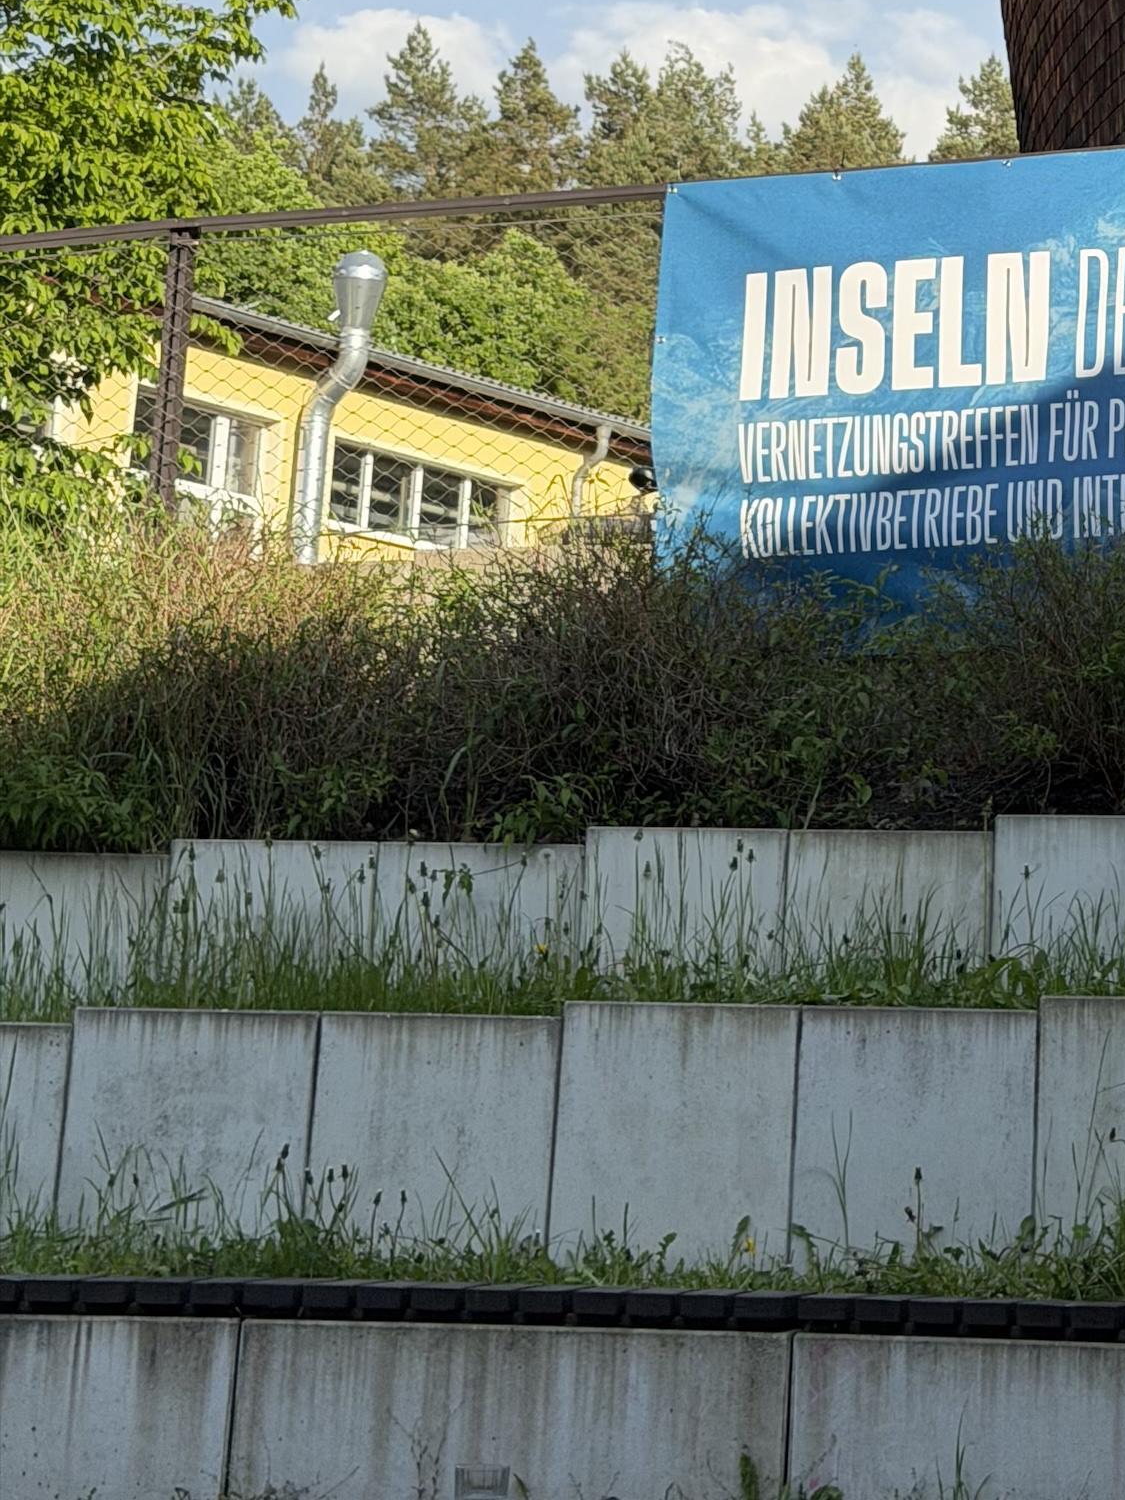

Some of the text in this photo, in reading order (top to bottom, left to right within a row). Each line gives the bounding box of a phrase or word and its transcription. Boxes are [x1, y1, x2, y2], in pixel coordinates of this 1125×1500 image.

[739, 251, 1050, 400] INSELN
[738, 403, 1038, 484] VERNETZUNGSTREFFEN
[1048, 388, 1098, 462] FÜR
[740, 483, 997, 560] KOLLEKTIVBETRIEBE
[1007, 478, 1064, 541] UND
